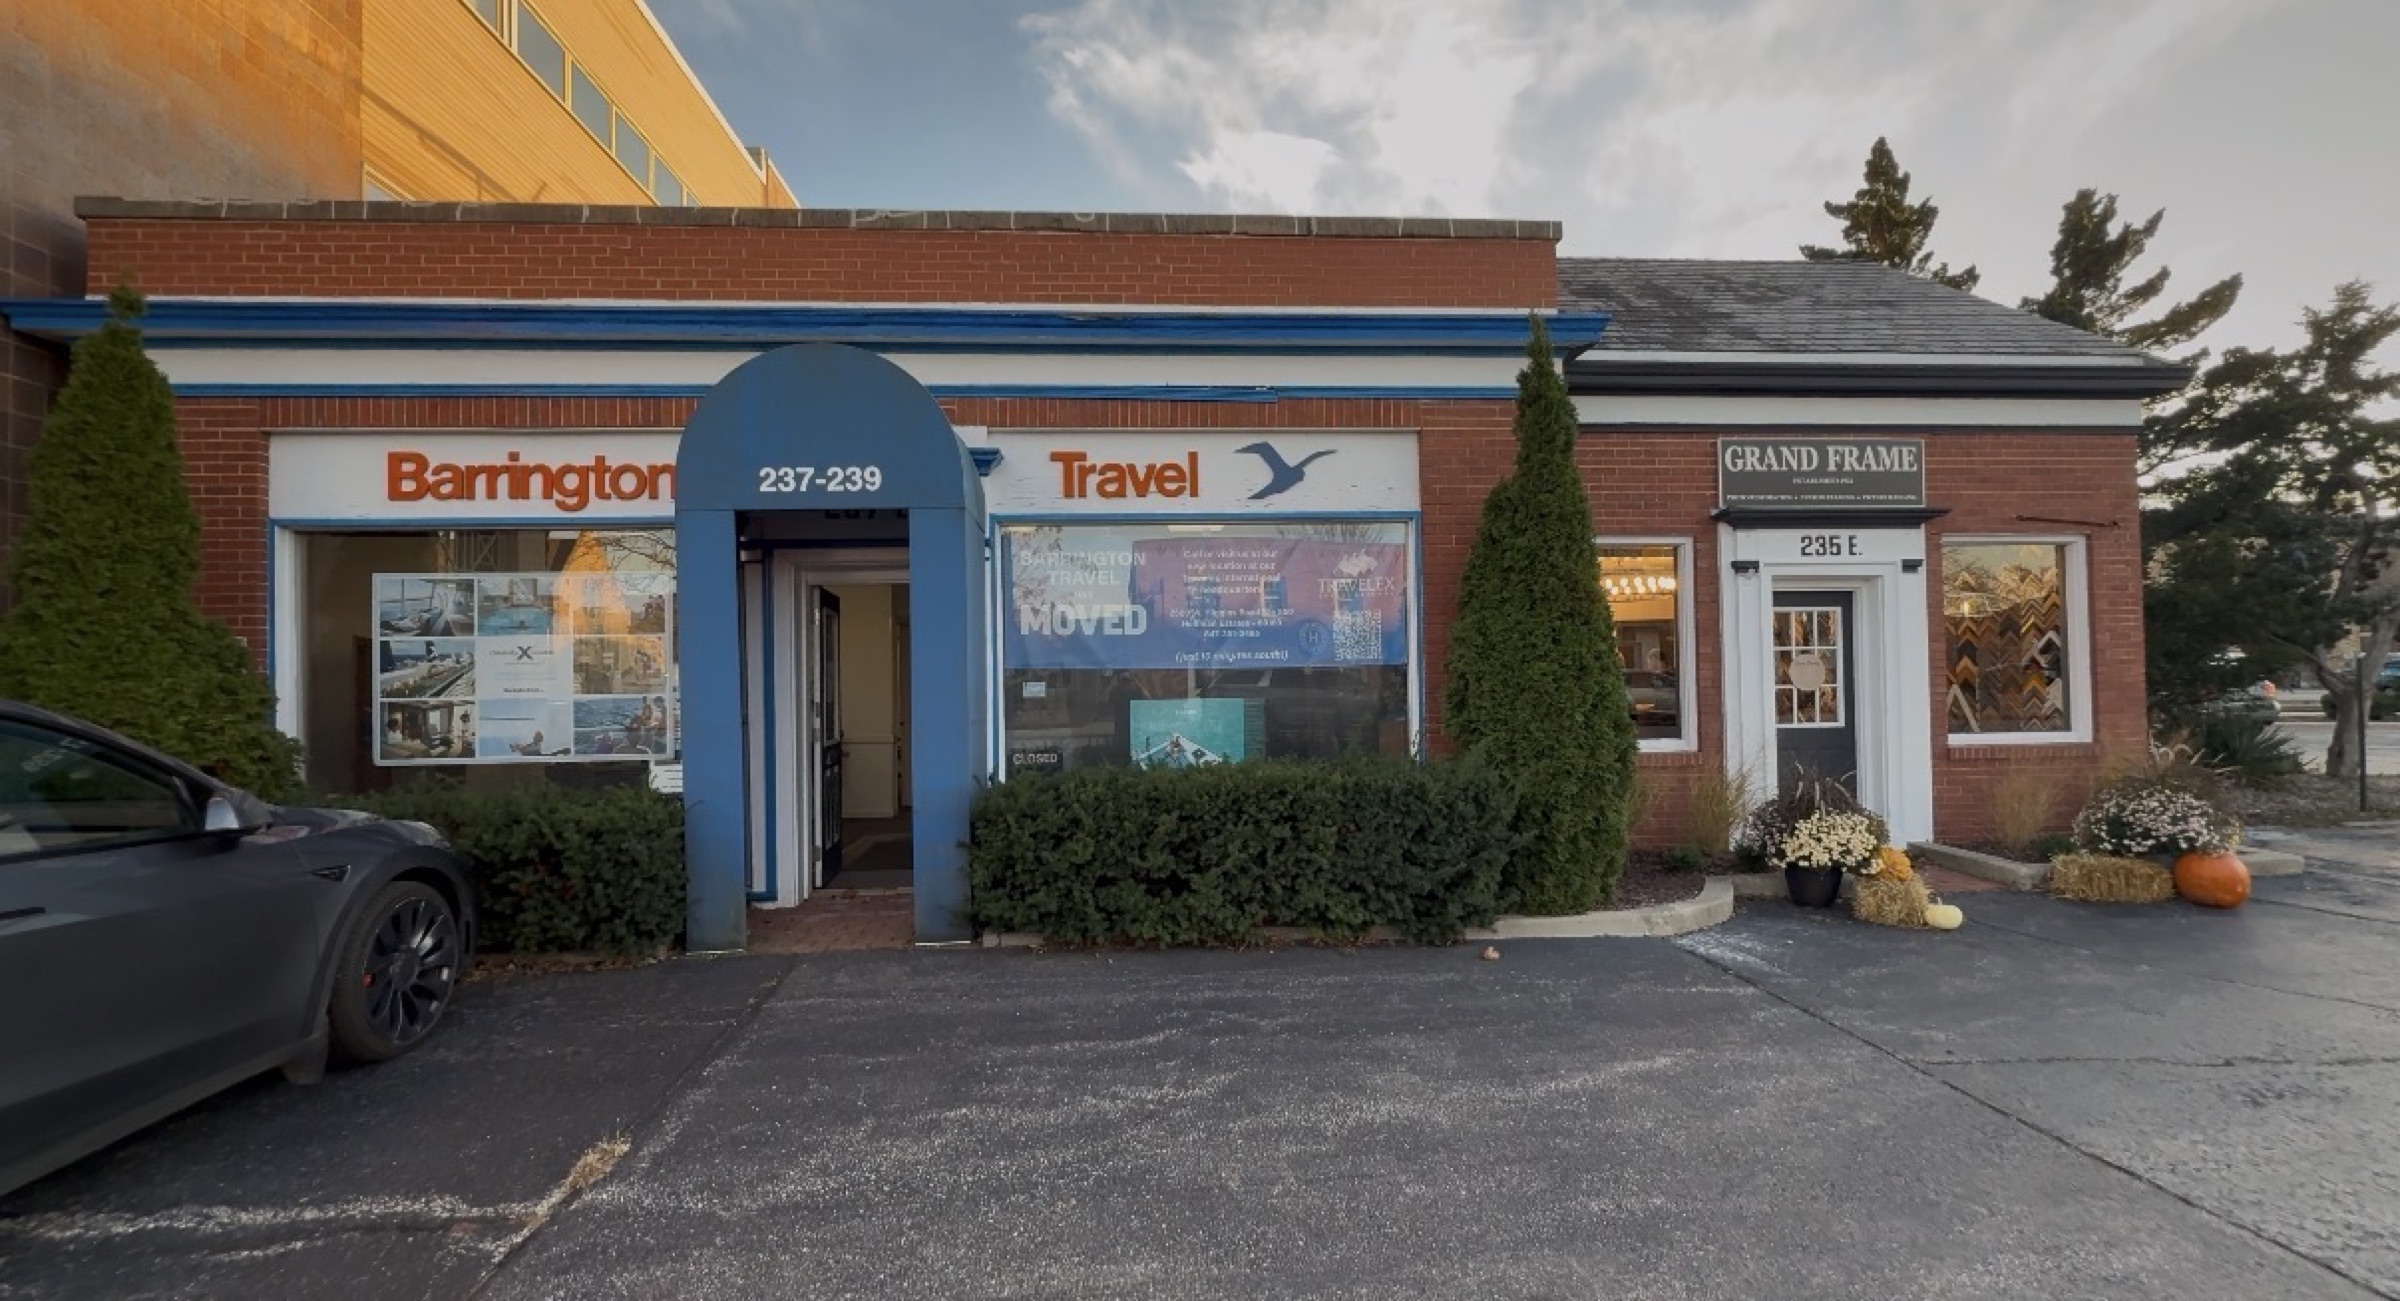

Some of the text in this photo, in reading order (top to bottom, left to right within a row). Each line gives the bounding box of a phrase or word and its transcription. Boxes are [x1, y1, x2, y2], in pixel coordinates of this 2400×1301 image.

[1724, 445, 1917, 472] GRAND FRAME
[387, 451, 676, 512] Barrington
[759, 466, 882, 492] 237-239
[1049, 451, 1199, 498] Travel
[1801, 535, 1863, 556] 235 E.
[1020, 551, 1147, 566] BARRINGTON
[1047, 570, 1121, 586] TRAVEL
[1318, 576, 1395, 593] TRAVELEX
[1020, 604, 1147, 635] MOVED
[1012, 753, 1058, 764] CLOSED
